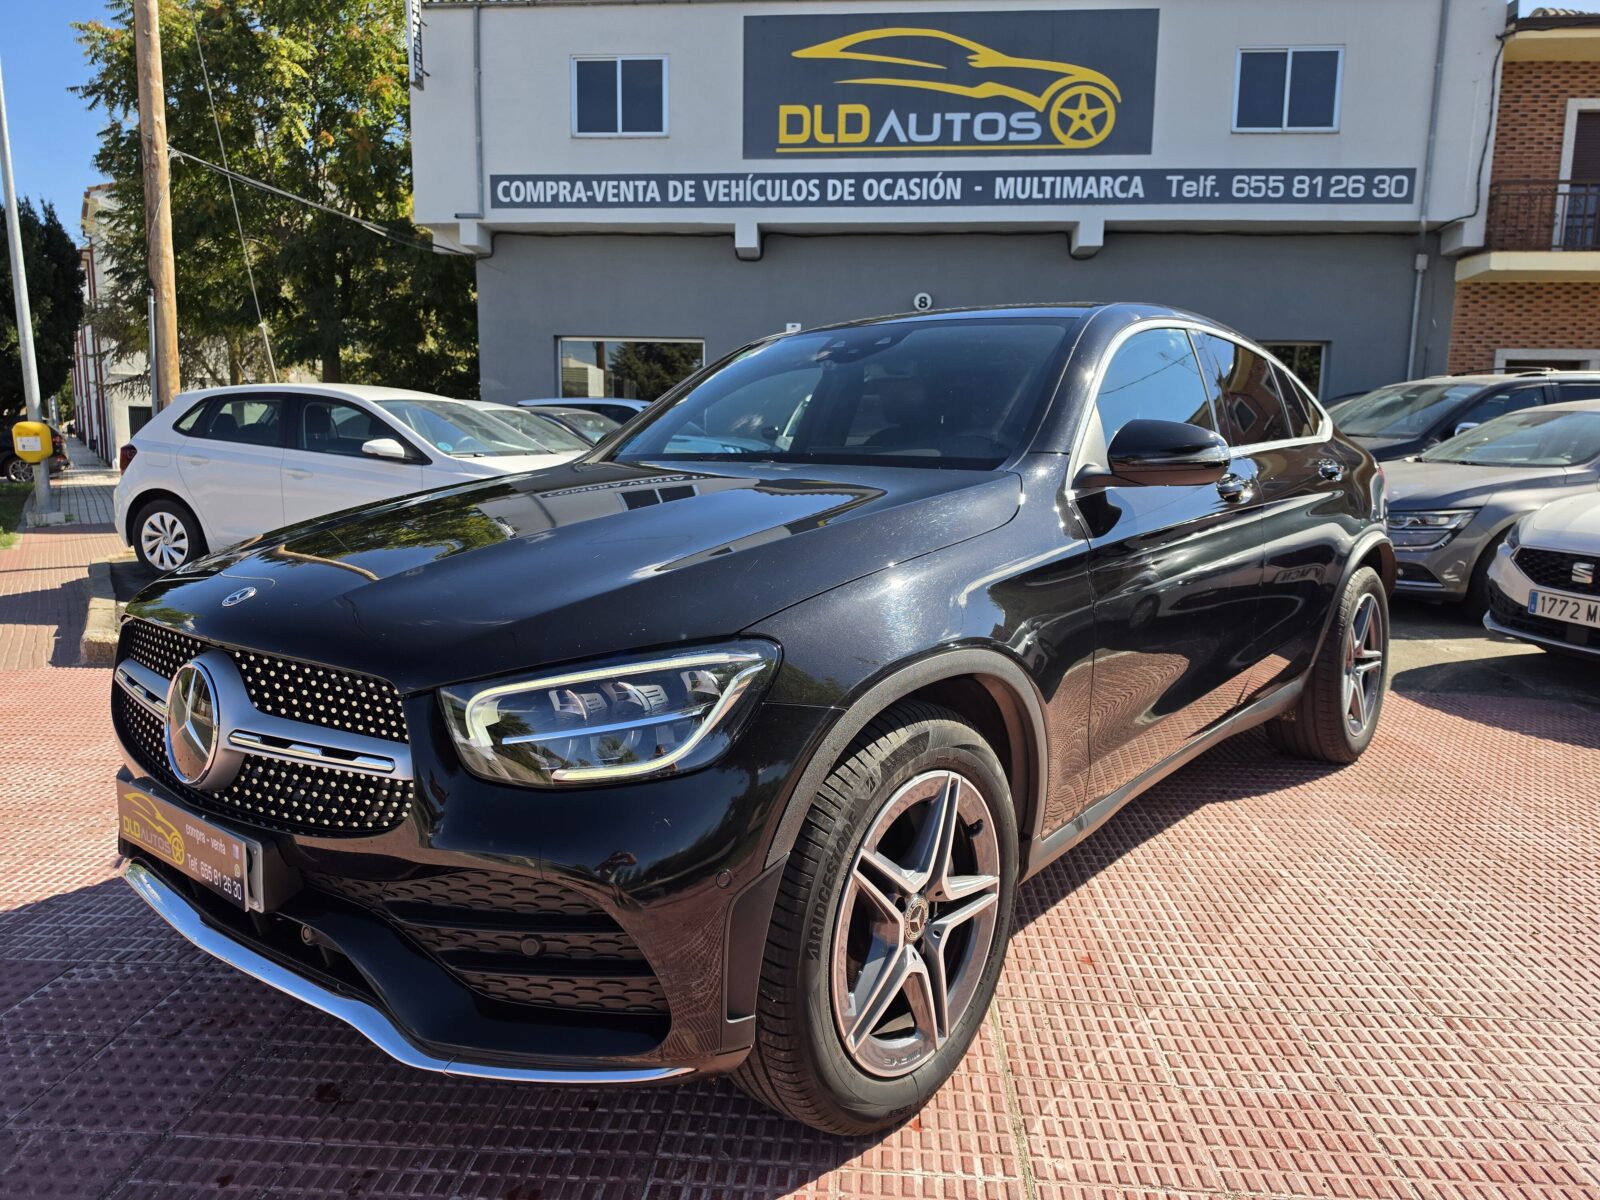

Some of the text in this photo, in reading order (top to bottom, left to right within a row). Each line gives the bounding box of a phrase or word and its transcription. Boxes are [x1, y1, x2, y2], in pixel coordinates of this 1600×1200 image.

[778, 104, 1043, 144] DLD AUTOS
[497, 180, 661, 203] COMPRA-VENTA
[668, 179, 696, 202] DE
[703, 174, 820, 202] VEHÍCULOS
[827, 178, 856, 201] DE
[862, 172, 962, 201] OCASIÓN
[994, 176, 1145, 200] MULTIMARCA
[1166, 174, 1221, 198] Telf.
[1231, 174, 1285, 198] 655
[1372, 174, 1410, 198] 30
[918, 296, 928, 309] 8
[1541, 597, 1600, 622] 1772 M
[123, 816, 172, 855] DLD AUTOS
[185, 824, 206, 844] compra
[210, 837, 226, 855] venta
[200, 861, 213, 882] 655
[213, 869, 222, 888] 81
[223, 875, 232, 895] 26
[232, 881, 242, 901] 30
